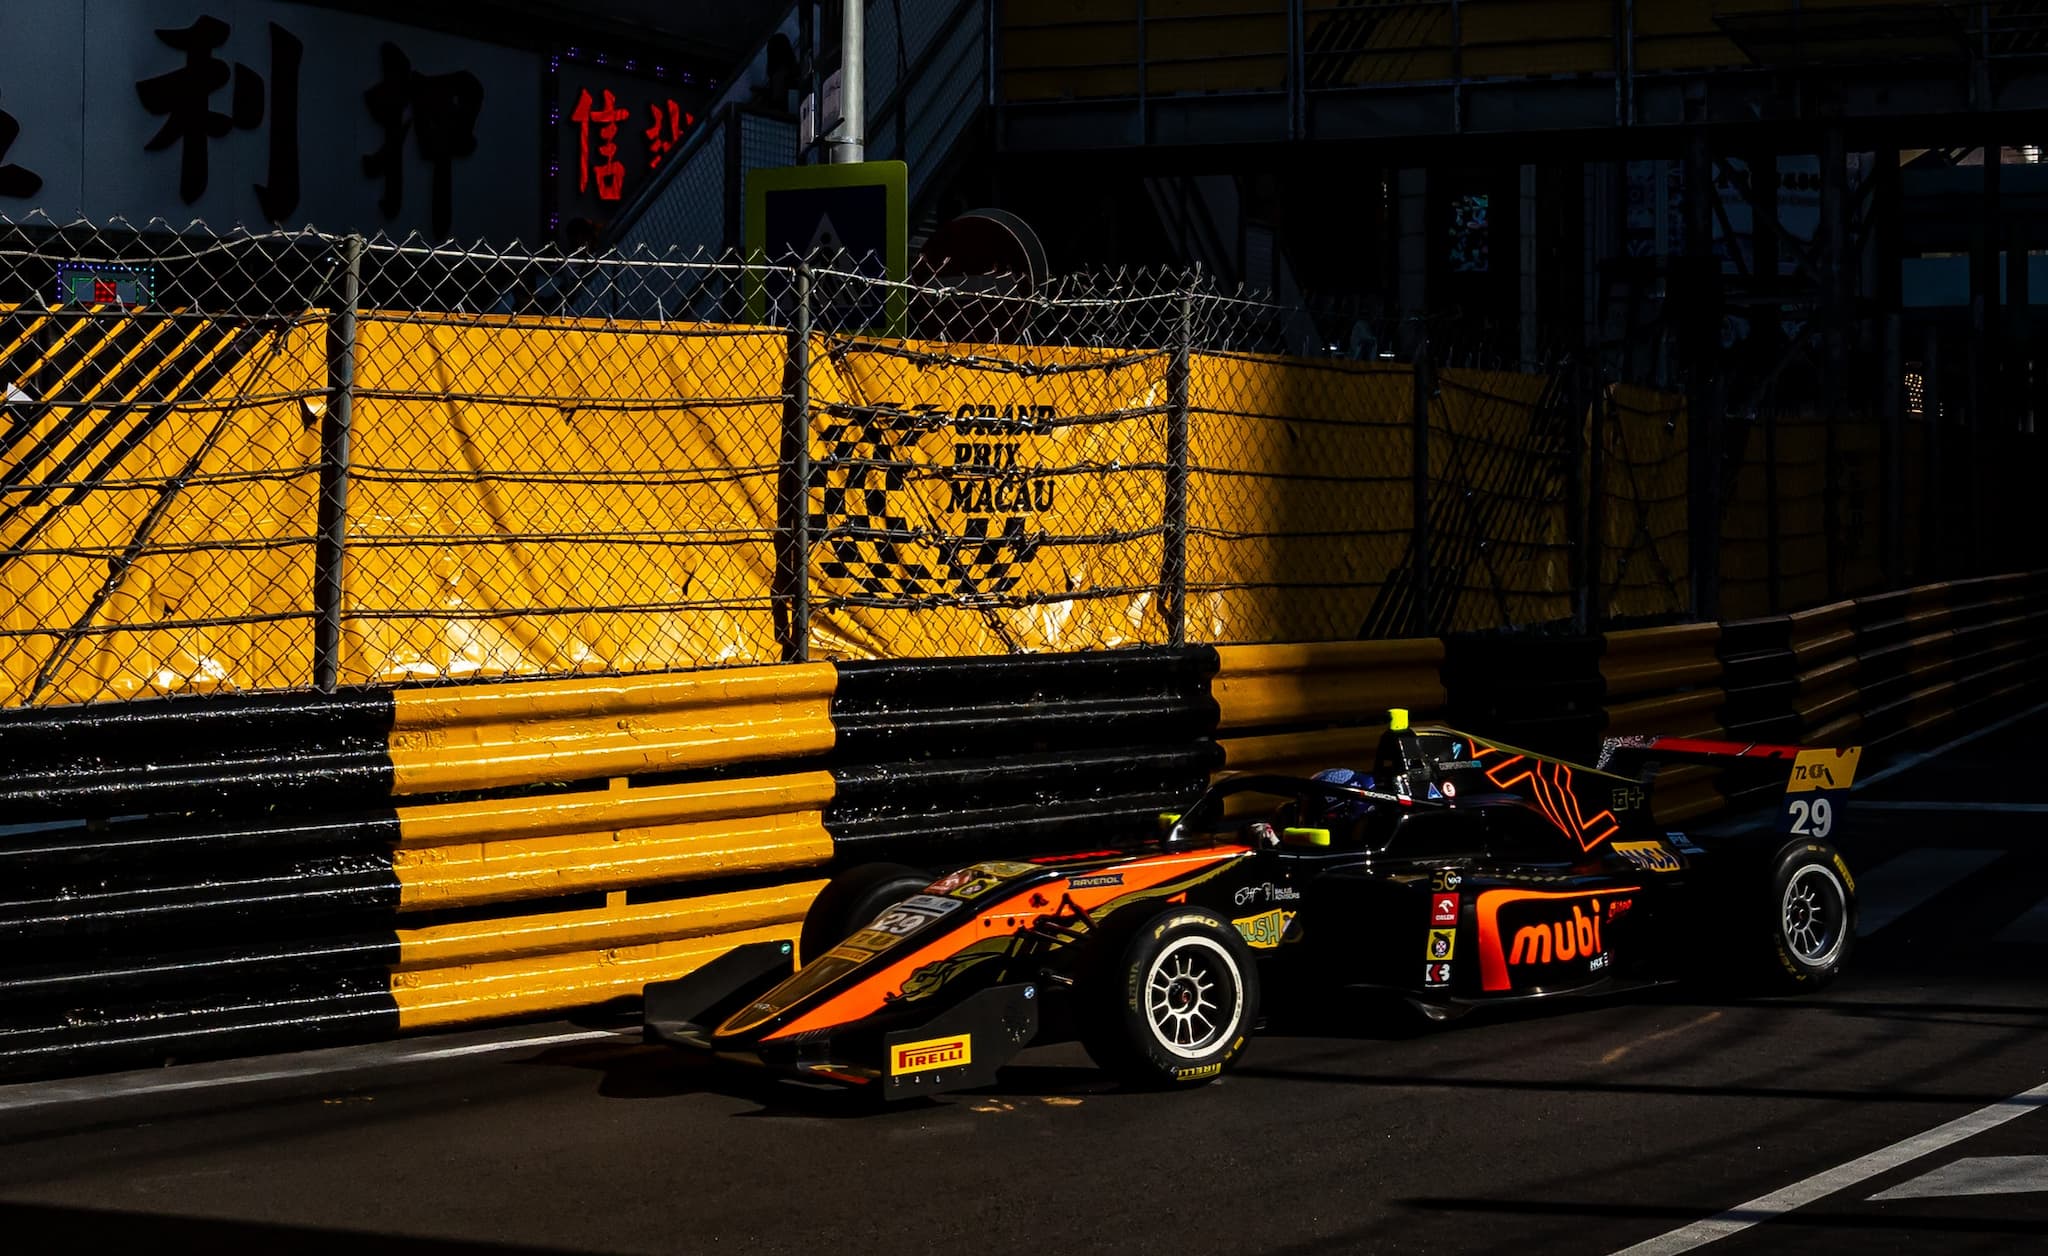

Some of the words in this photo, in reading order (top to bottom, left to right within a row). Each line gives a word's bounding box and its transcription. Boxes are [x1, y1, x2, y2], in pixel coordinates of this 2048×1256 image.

[0, 15, 484, 241] 利押
[955, 404, 1056, 435] GRAND
[954, 443, 1021, 474] PRIX
[946, 479, 1056, 513] MACAU
[1788, 798, 1832, 838] 29
[1072, 876, 1120, 887] RAVENOL
[872, 913, 926, 934] 29
[1508, 897, 1602, 966] mubi
[899, 1042, 963, 1068] PIRELLI
